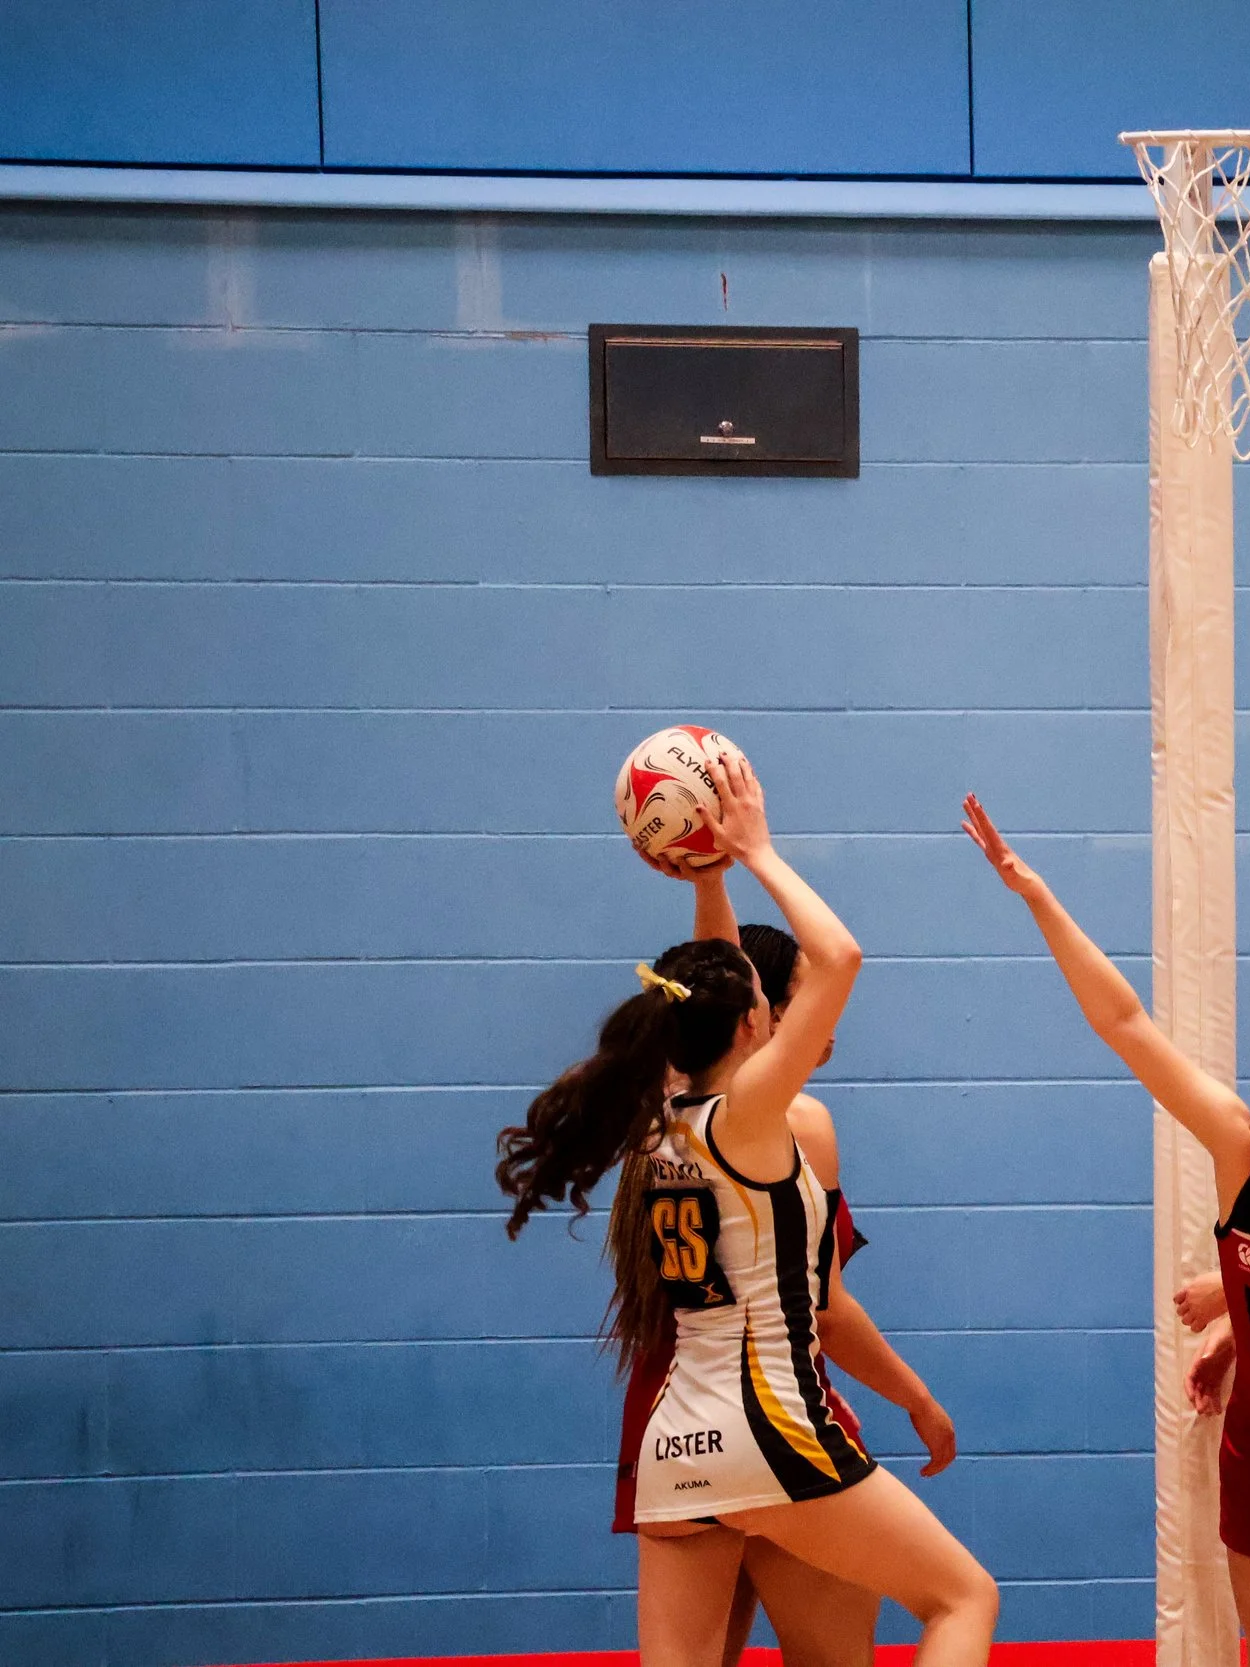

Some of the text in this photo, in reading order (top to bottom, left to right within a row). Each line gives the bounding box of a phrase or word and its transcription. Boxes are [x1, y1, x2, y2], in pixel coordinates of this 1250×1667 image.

[651, 1197, 709, 1283] GS
[655, 1429, 724, 1461] LISTER
[674, 1479, 712, 1491] AKUMA
